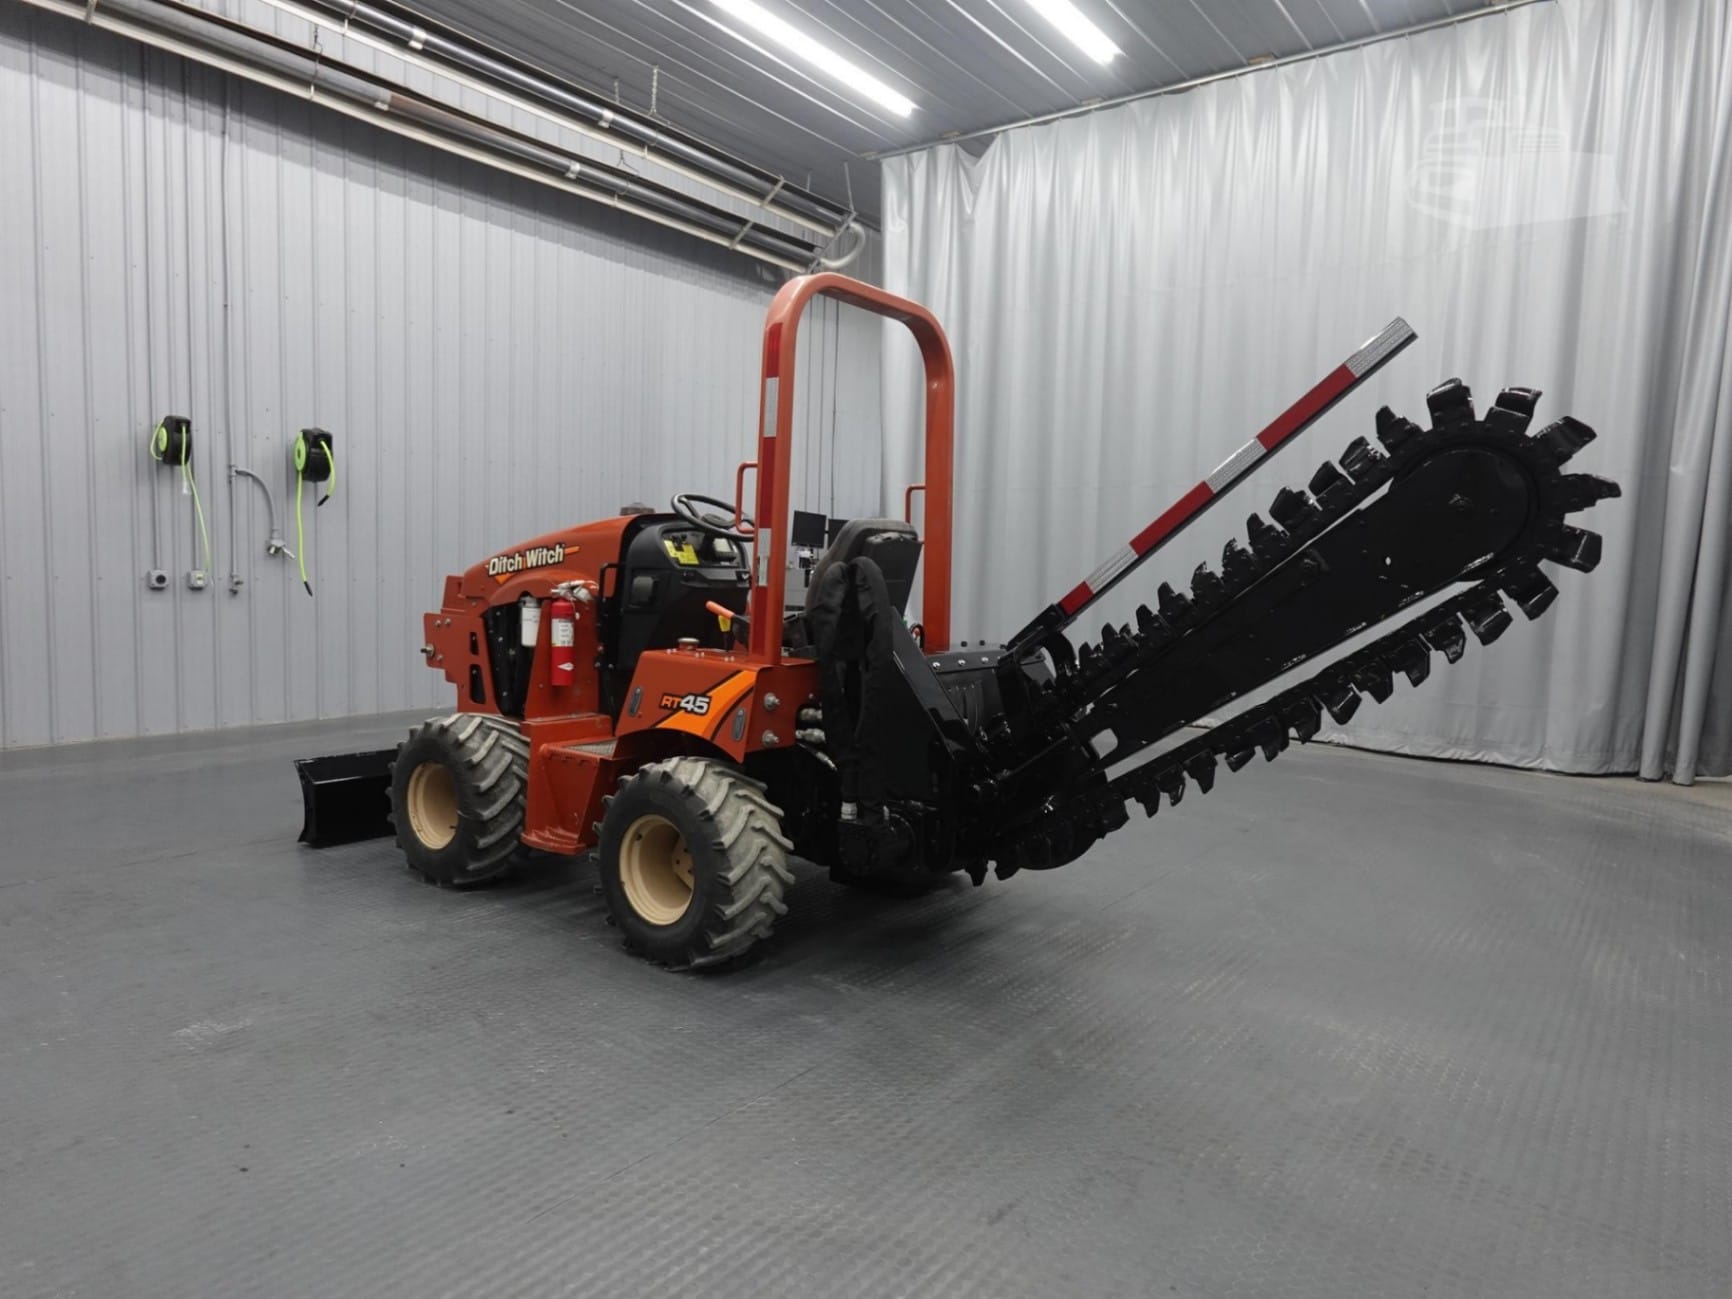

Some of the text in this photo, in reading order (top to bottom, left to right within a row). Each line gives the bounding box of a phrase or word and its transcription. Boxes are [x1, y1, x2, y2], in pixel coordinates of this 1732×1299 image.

[488, 543, 565, 576] Ditch Witch
[660, 694, 710, 715] RT45
